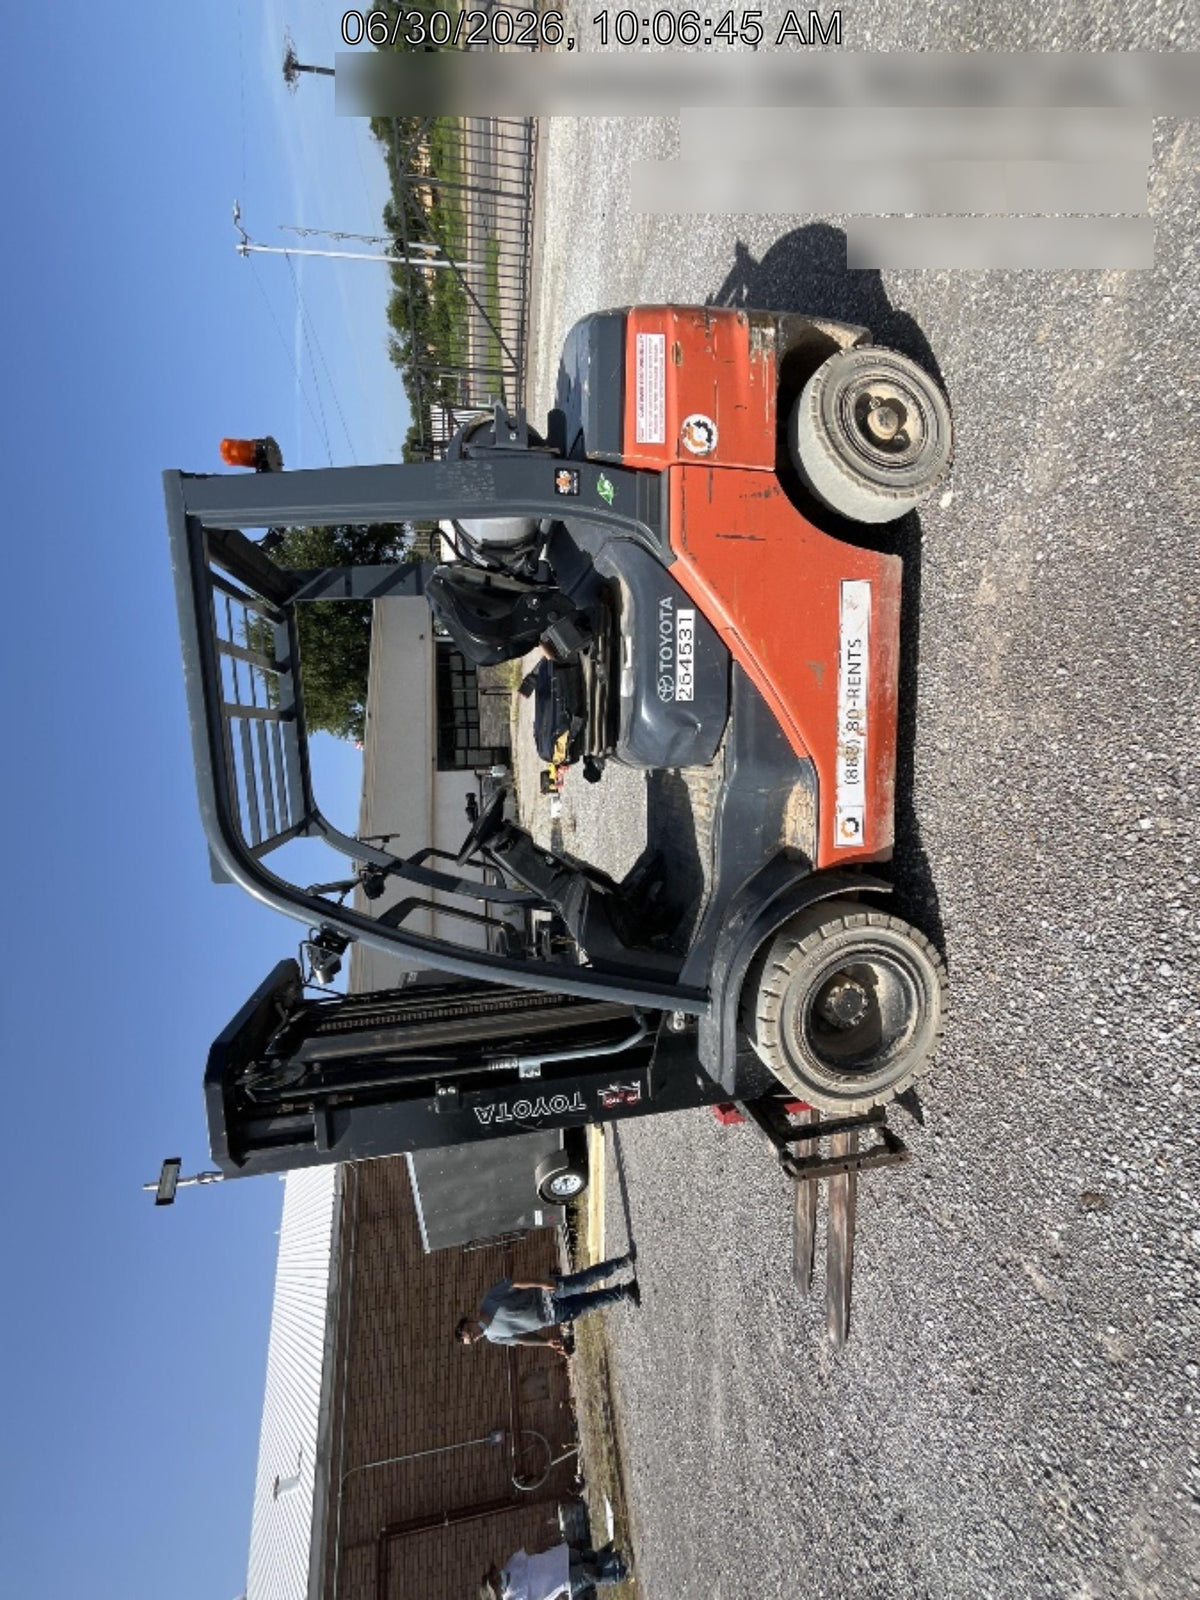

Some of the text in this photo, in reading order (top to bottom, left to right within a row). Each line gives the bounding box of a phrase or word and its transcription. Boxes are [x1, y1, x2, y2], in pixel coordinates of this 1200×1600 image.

[659, 596, 673, 673] TOYOTA
[678, 617, 693, 700] 264531
[473, 1091, 587, 1125] TOYOTA
